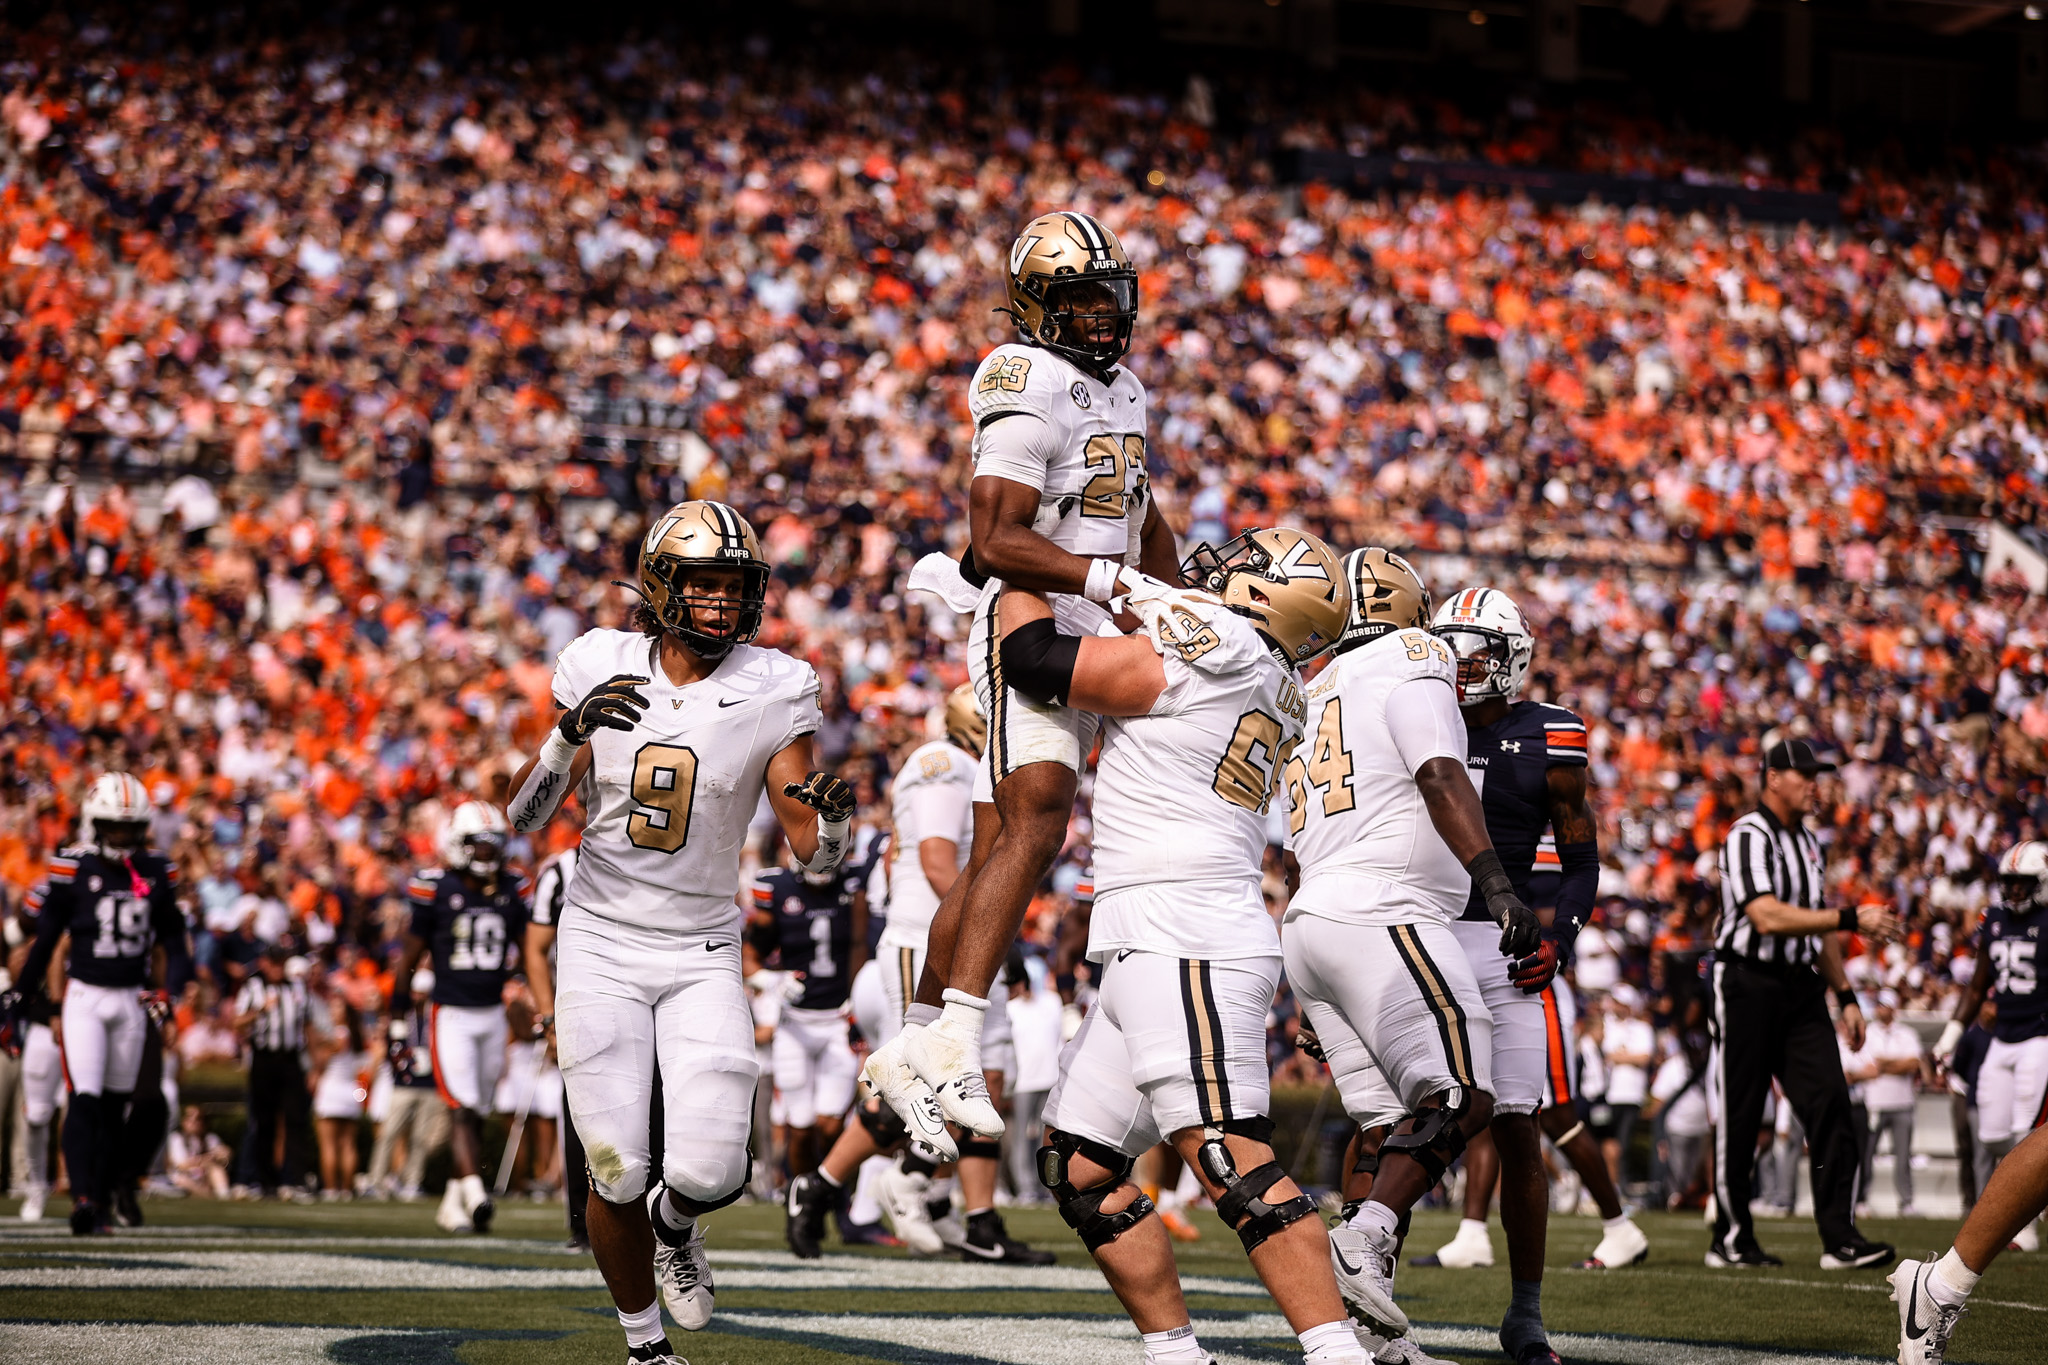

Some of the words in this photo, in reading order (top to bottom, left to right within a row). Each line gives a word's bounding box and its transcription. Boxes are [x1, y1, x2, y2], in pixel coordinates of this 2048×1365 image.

[1092, 260, 1118, 270] VUFB
[978, 355, 1032, 394] 23
[646, 516, 684, 554] V
[724, 548, 749, 559] VUFB
[626, 741, 699, 856] 9
[93, 896, 151, 958] 19
[449, 913, 506, 970] 10
[808, 916, 837, 977] 1
